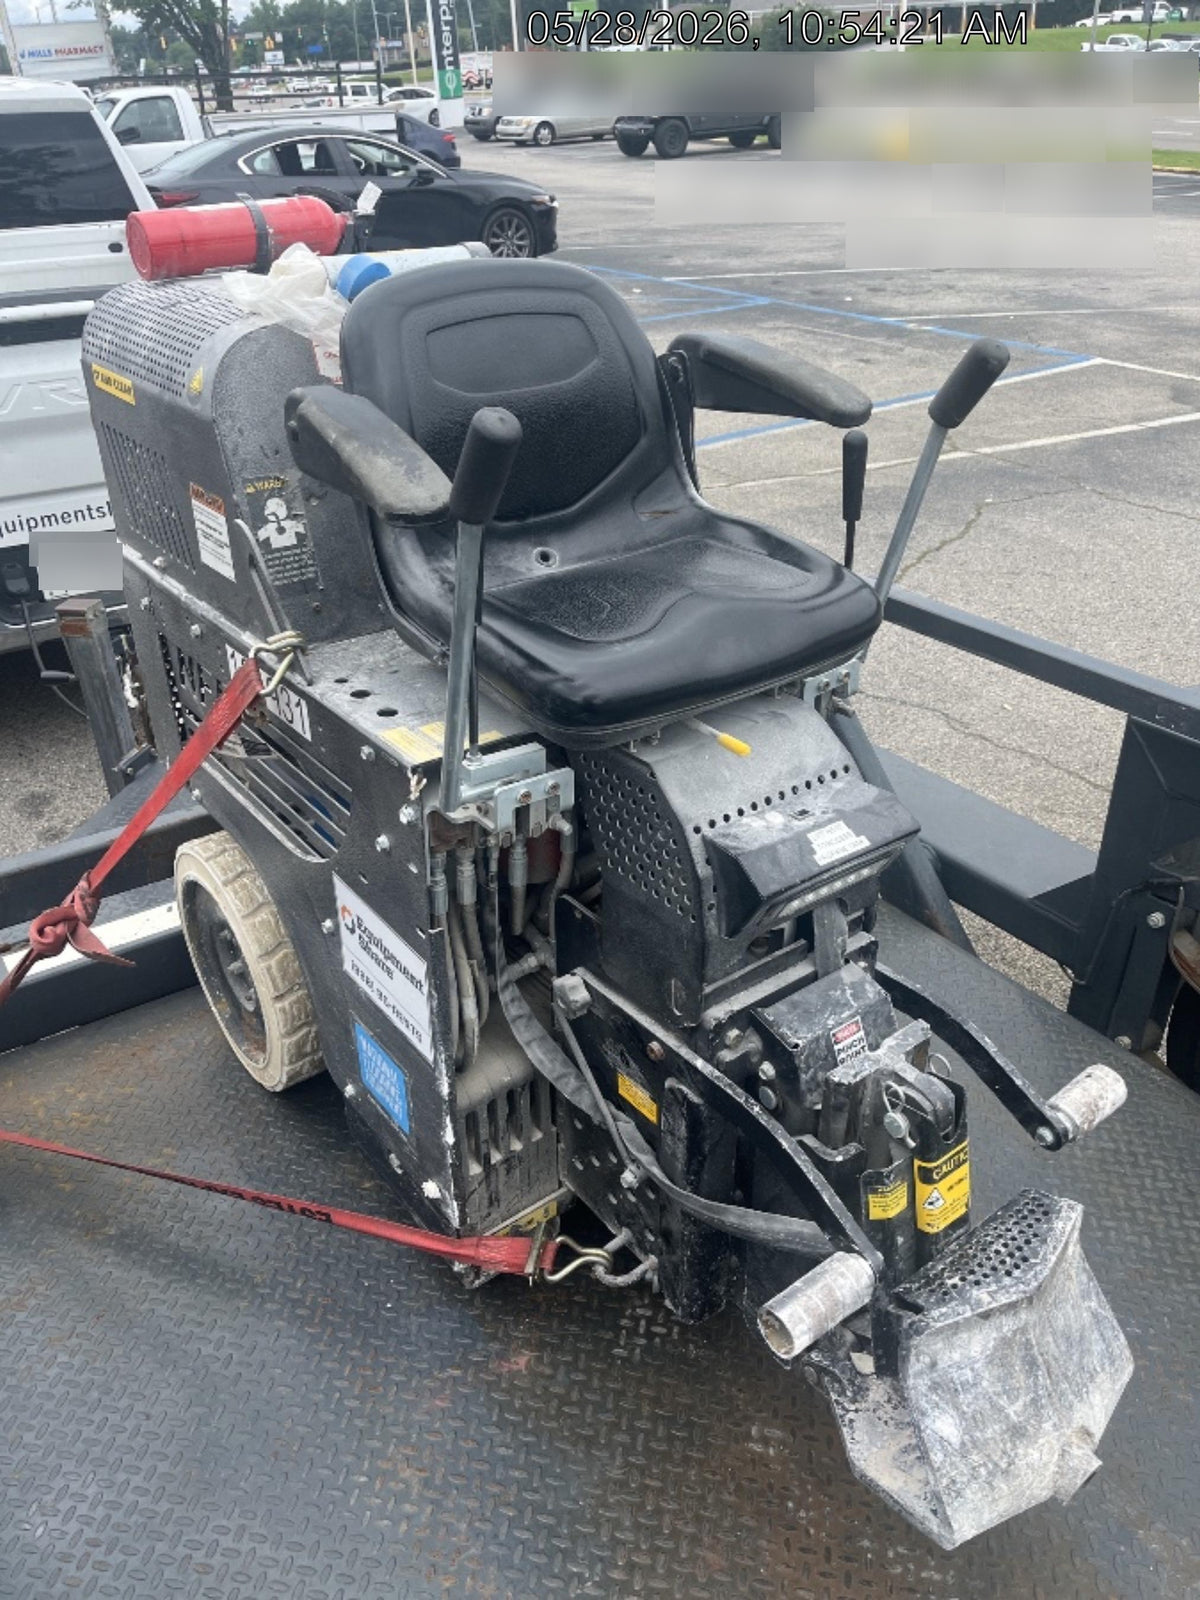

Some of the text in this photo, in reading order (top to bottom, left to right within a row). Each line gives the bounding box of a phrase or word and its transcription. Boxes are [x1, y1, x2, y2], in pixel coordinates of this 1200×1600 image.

[54, 45, 104, 57] PHARMACY
[439, 0, 456, 98] enterp
[355, 914, 425, 996] Equipment
[358, 933, 394, 981] Share
